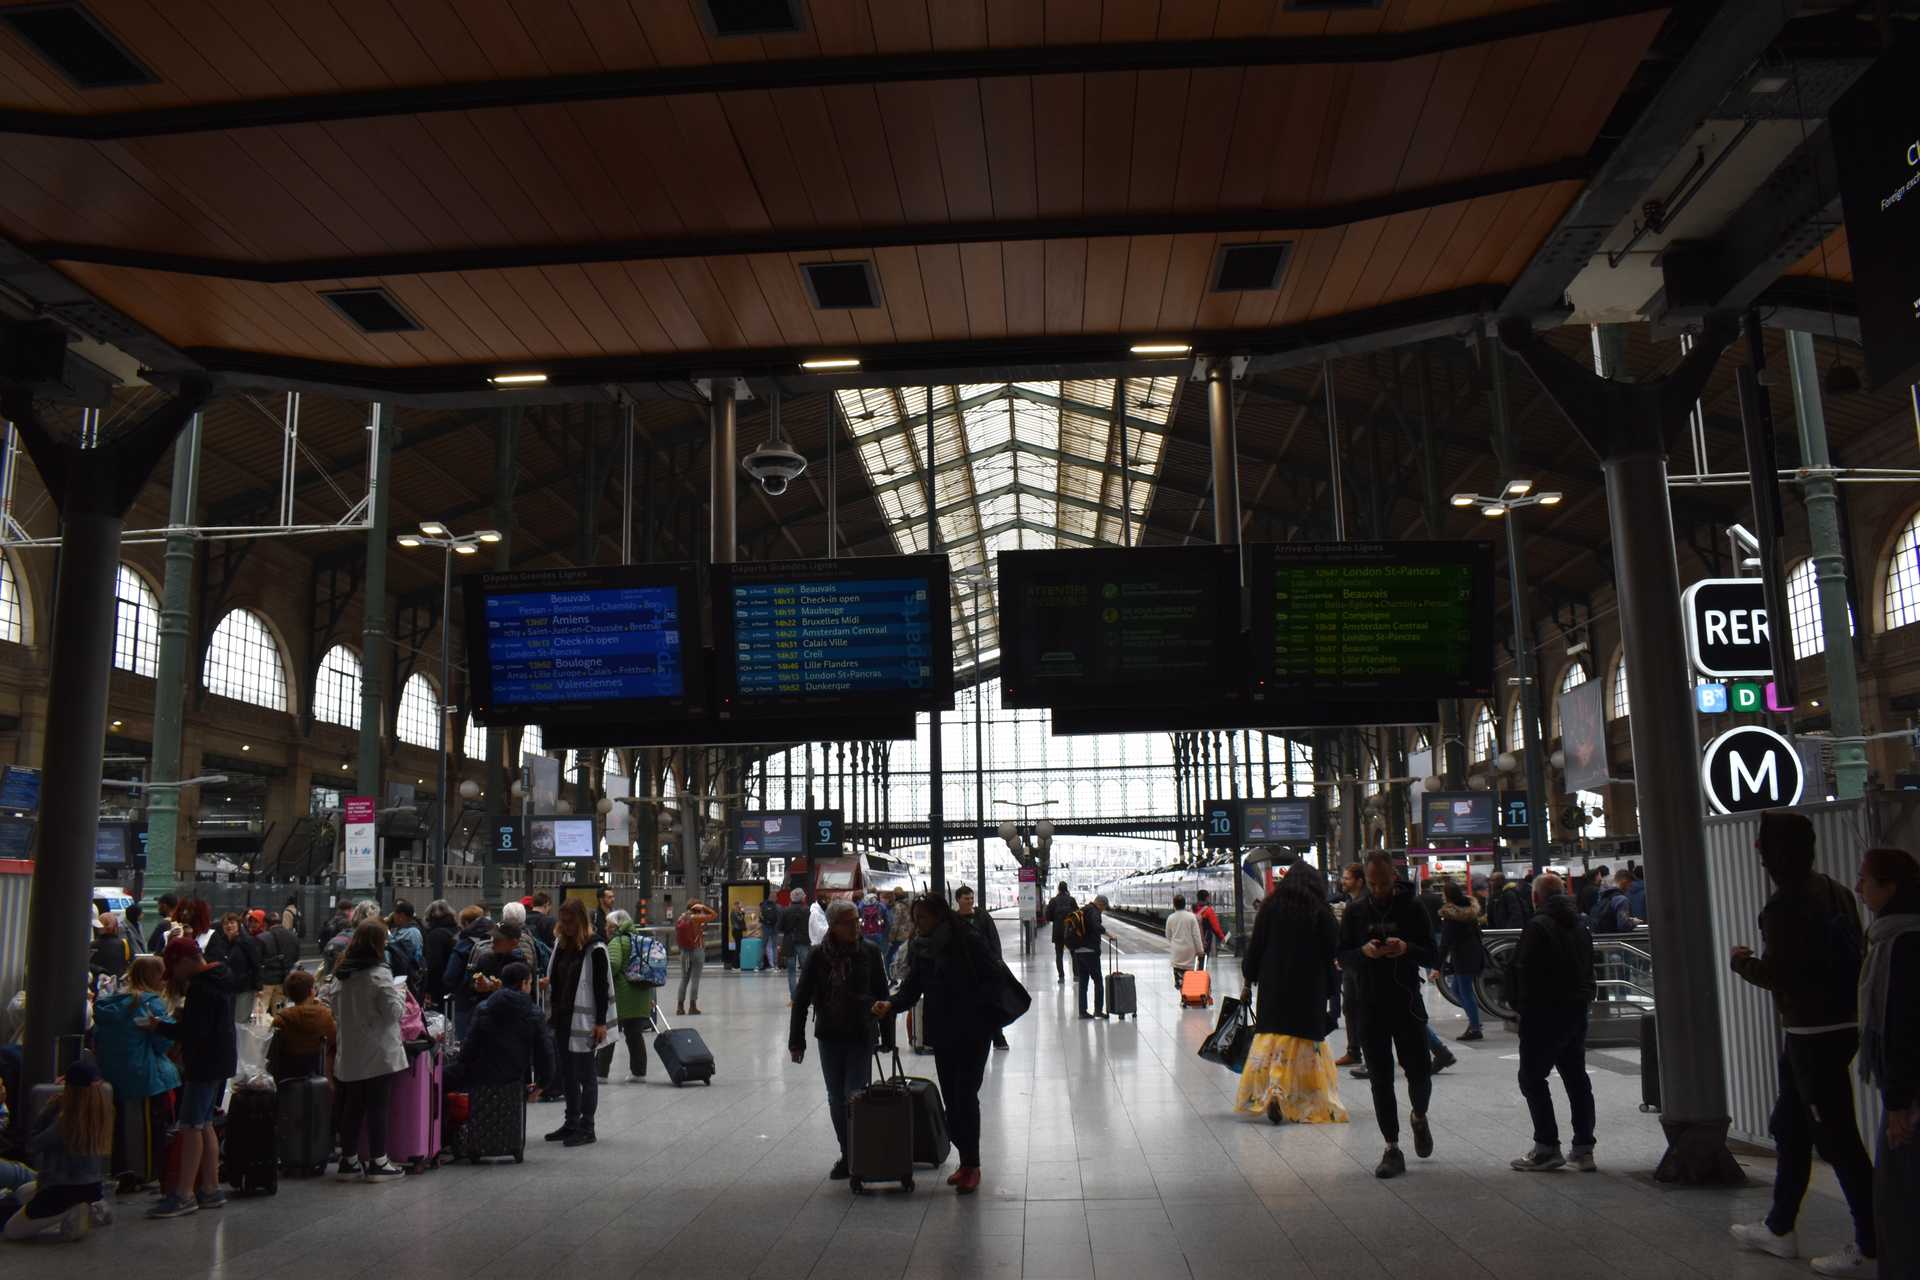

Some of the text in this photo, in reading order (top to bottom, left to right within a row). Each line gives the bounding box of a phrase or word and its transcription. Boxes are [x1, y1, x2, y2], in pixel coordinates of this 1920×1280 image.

[1343, 567, 1382, 577] London
[800, 584, 837, 594] Beauvais
[551, 591, 592, 604] Beauvais
[801, 595, 838, 605] Check-in
[839, 594, 860, 605] open
[801, 607, 844, 618] Maubeuge
[552, 613, 590, 625] Amiens
[802, 617, 841, 627] Bruxelles
[842, 616, 861, 625] Midi
[803, 628, 850, 638] Amsterdam
[1704, 609, 1770, 646] RER
[554, 636, 595, 648] Check-in
[597, 635, 621, 648] open
[803, 639, 828, 648] Calais
[829, 638, 849, 648] Ville
[804, 650, 824, 659] Creil
[555, 656, 604, 671] Boulogne
[804, 661, 823, 670] Lille
[824, 659, 859, 669] Flandres
[805, 671, 836, 681] London
[556, 676, 623, 690] Valenciennes
[806, 682, 852, 693] Dunkerque
[1701, 688, 1756, 707] B D
[1728, 749, 1780, 802] M
[1508, 808, 1527, 825] 11
[1210, 817, 1231, 833] 10
[502, 833, 512, 848] 8
[821, 827, 832, 843] 9
